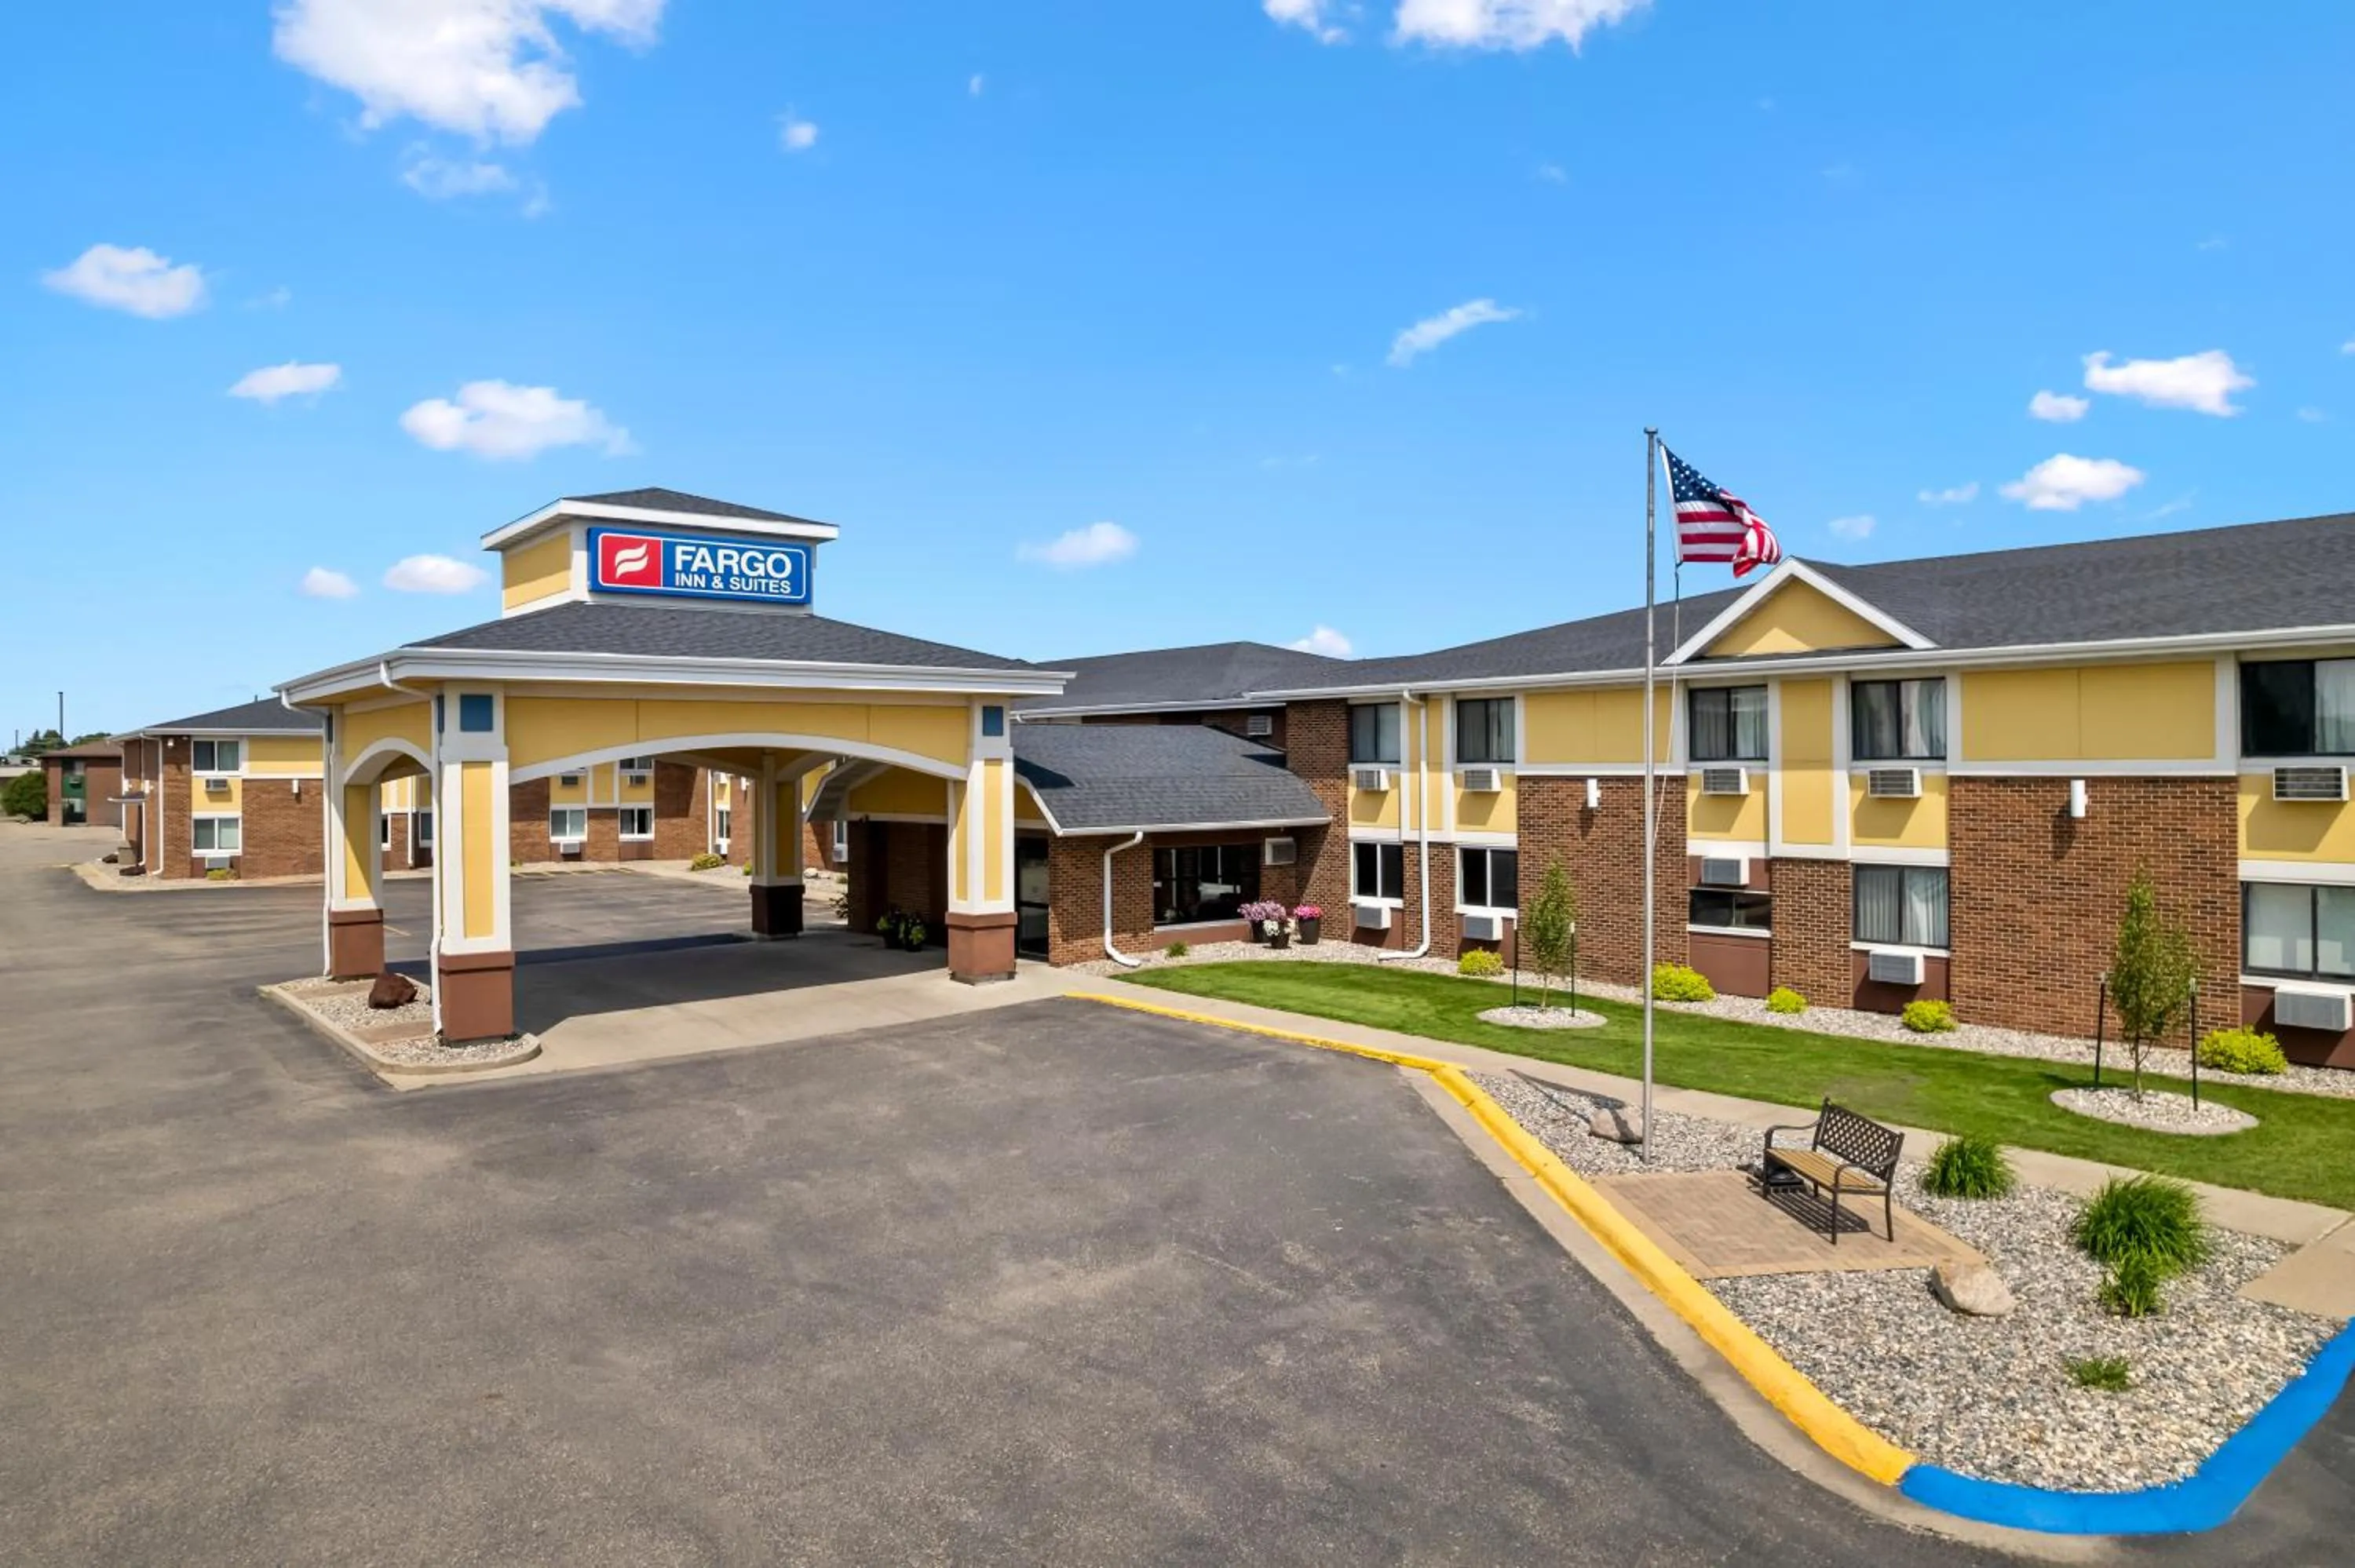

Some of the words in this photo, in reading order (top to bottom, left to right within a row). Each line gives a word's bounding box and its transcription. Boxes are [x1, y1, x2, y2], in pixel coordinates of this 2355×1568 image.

[675, 545, 791, 578] FARGO
[675, 572, 706, 588] INN
[712, 575, 724, 589] &
[729, 577, 791, 594] SUITES
